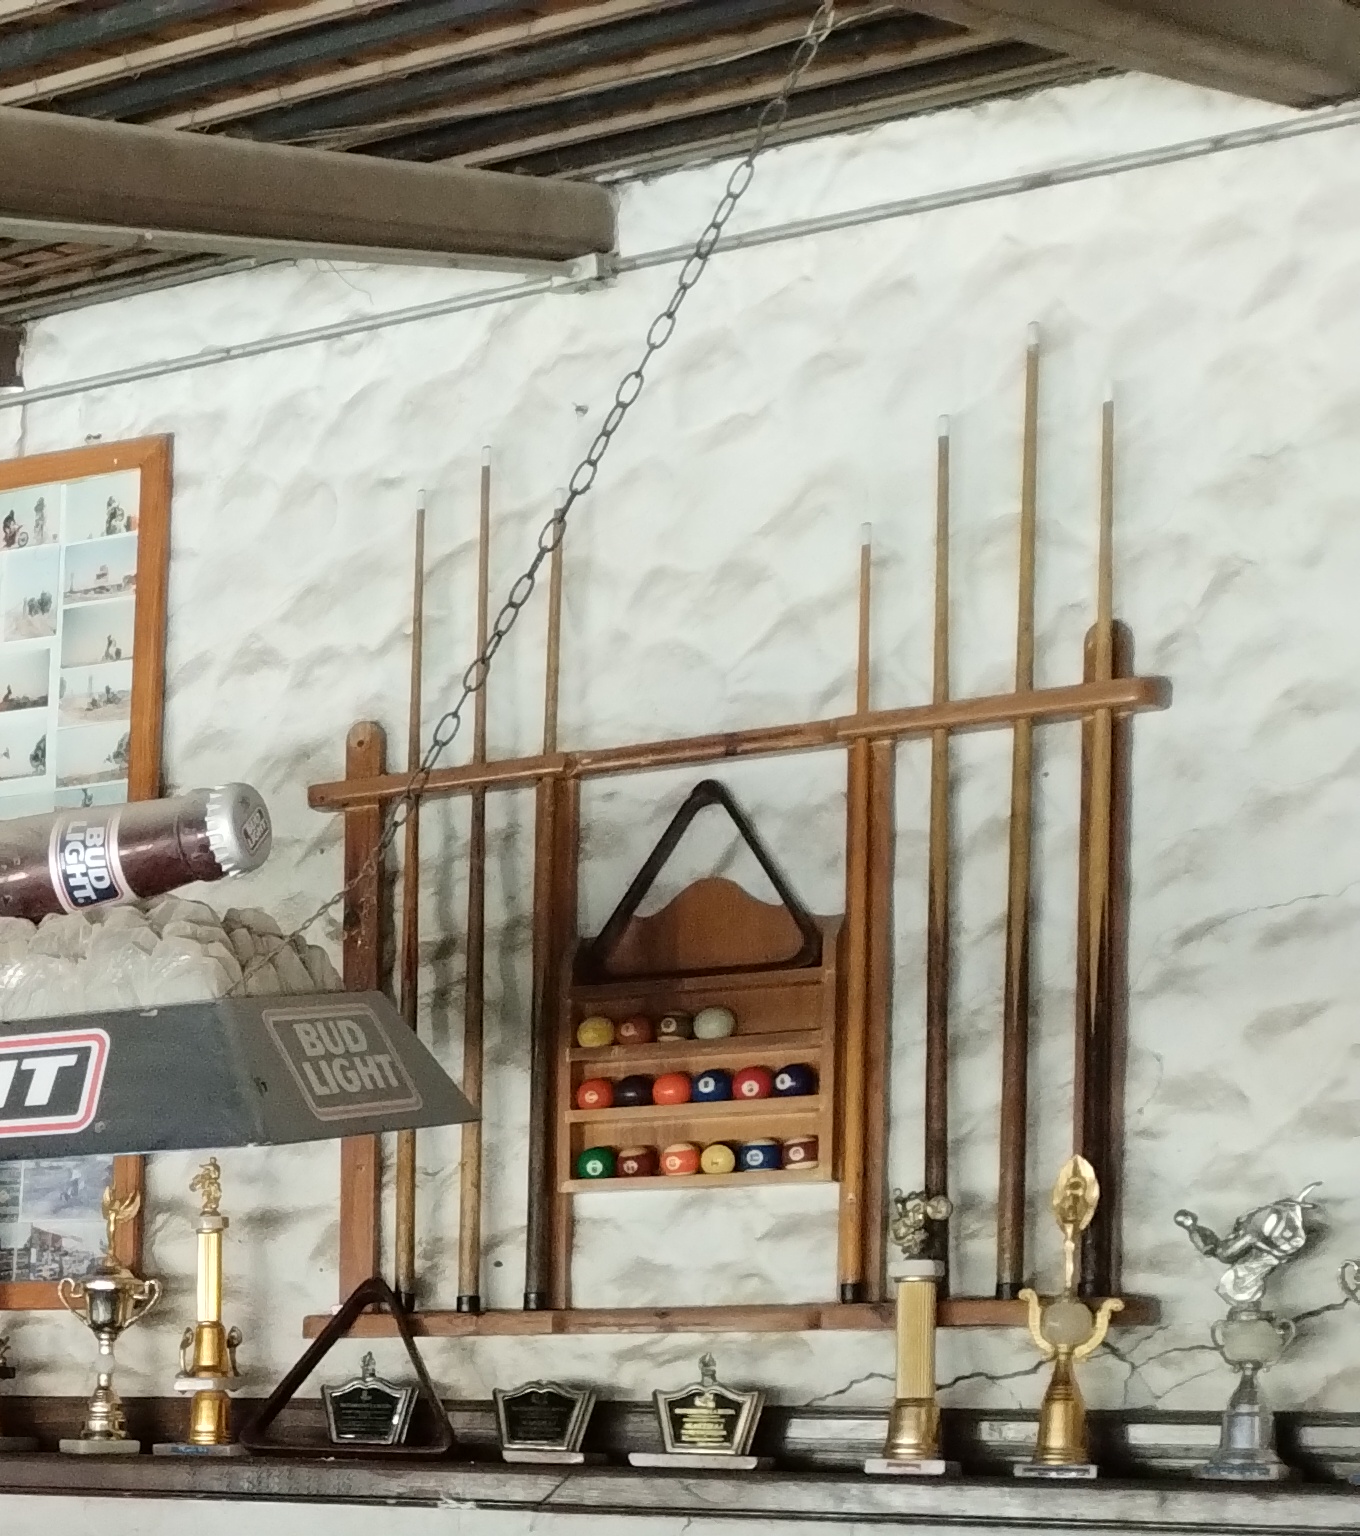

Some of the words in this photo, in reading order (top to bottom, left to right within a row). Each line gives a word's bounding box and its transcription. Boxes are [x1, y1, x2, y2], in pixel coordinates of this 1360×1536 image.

[65, 821, 97, 900] LIGHT
[85, 827, 111, 889] BUD
[293, 1020, 367, 1056] BUD
[302, 1054, 399, 1095] LIGHT
